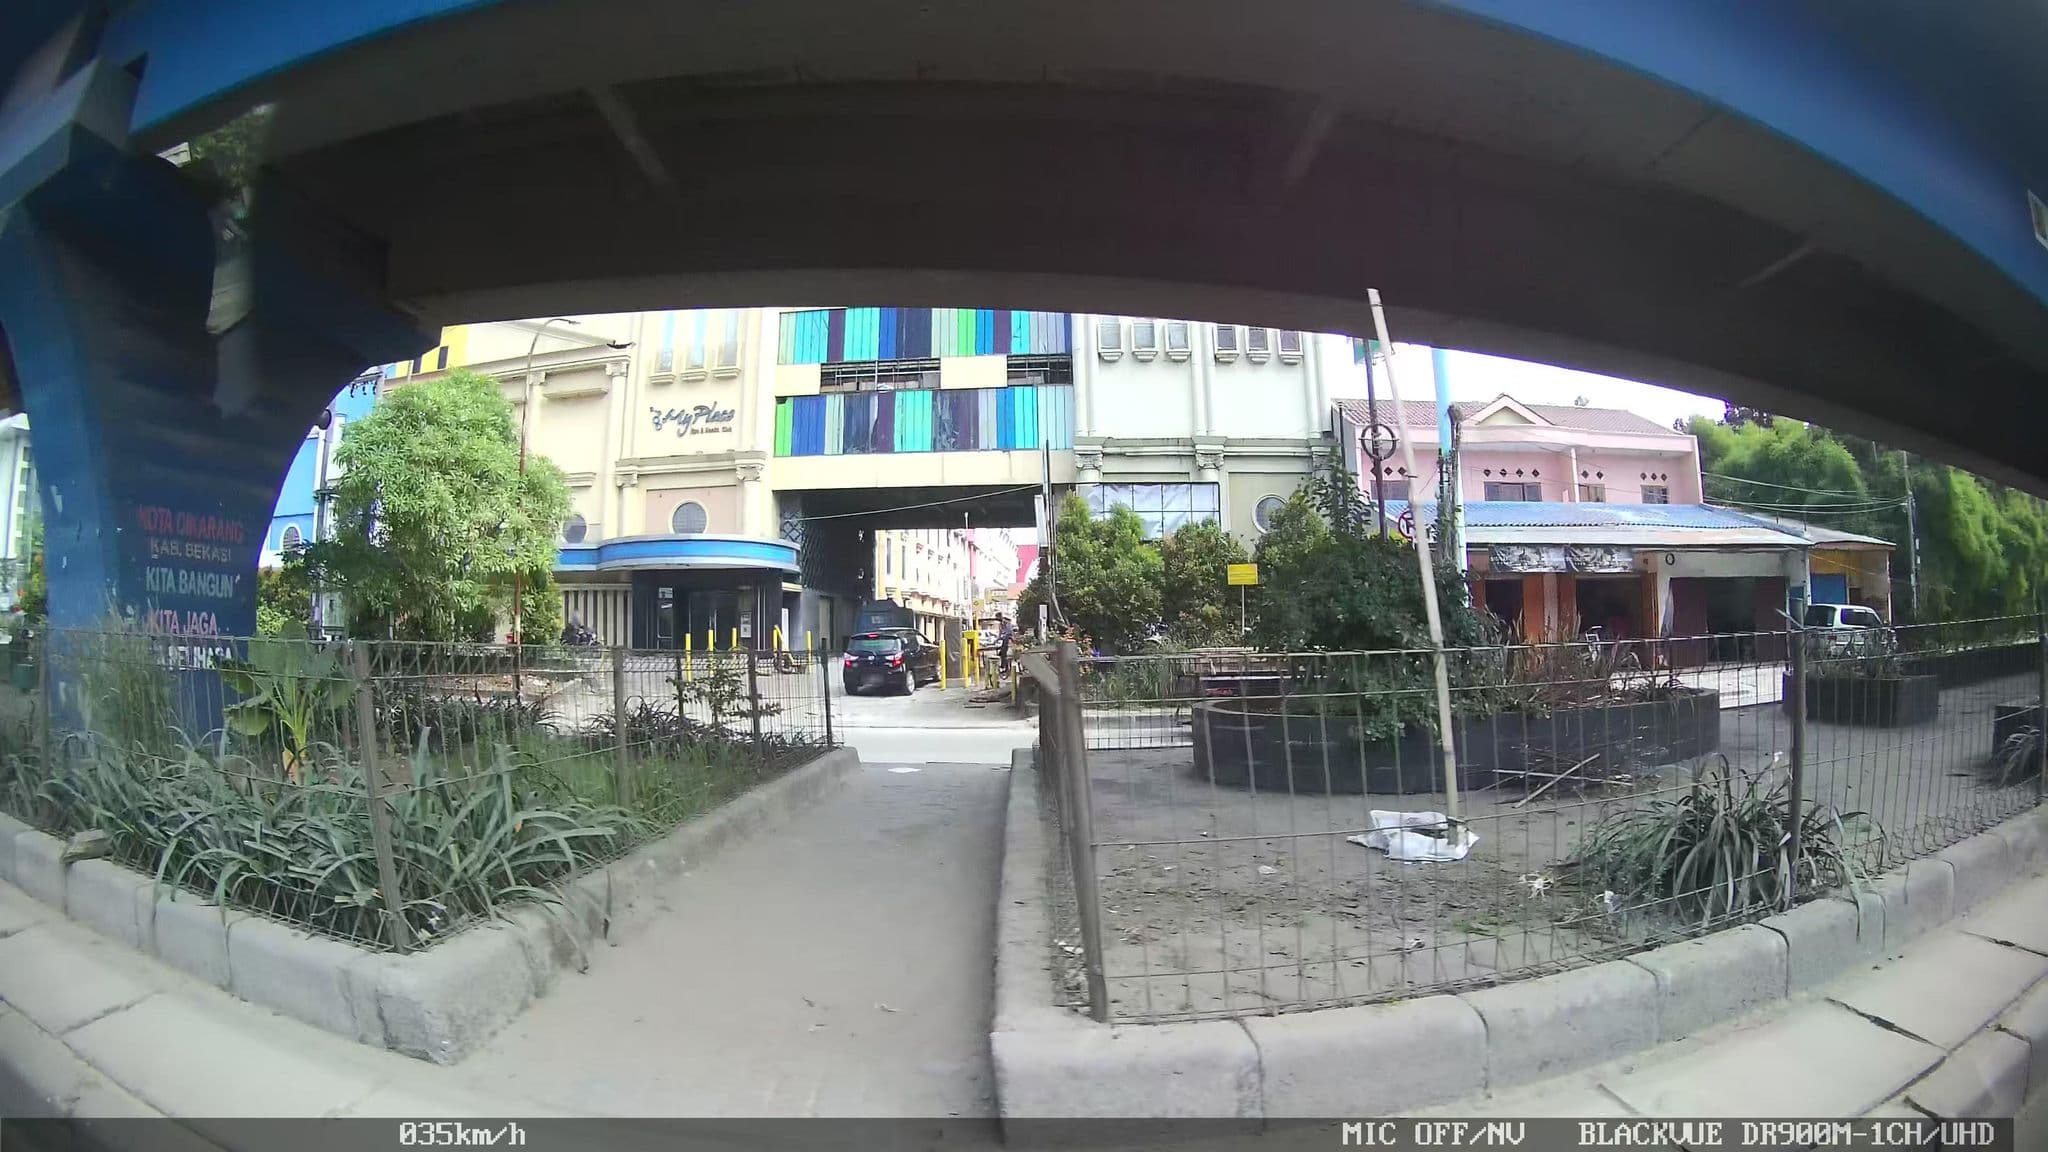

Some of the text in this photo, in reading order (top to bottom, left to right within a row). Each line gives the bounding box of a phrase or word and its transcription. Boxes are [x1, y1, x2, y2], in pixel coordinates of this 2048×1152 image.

[185, 542, 231, 562] BEKASI
[146, 566, 233, 598] KITA BANGUN
[148, 608, 218, 637] KITA JAGA
